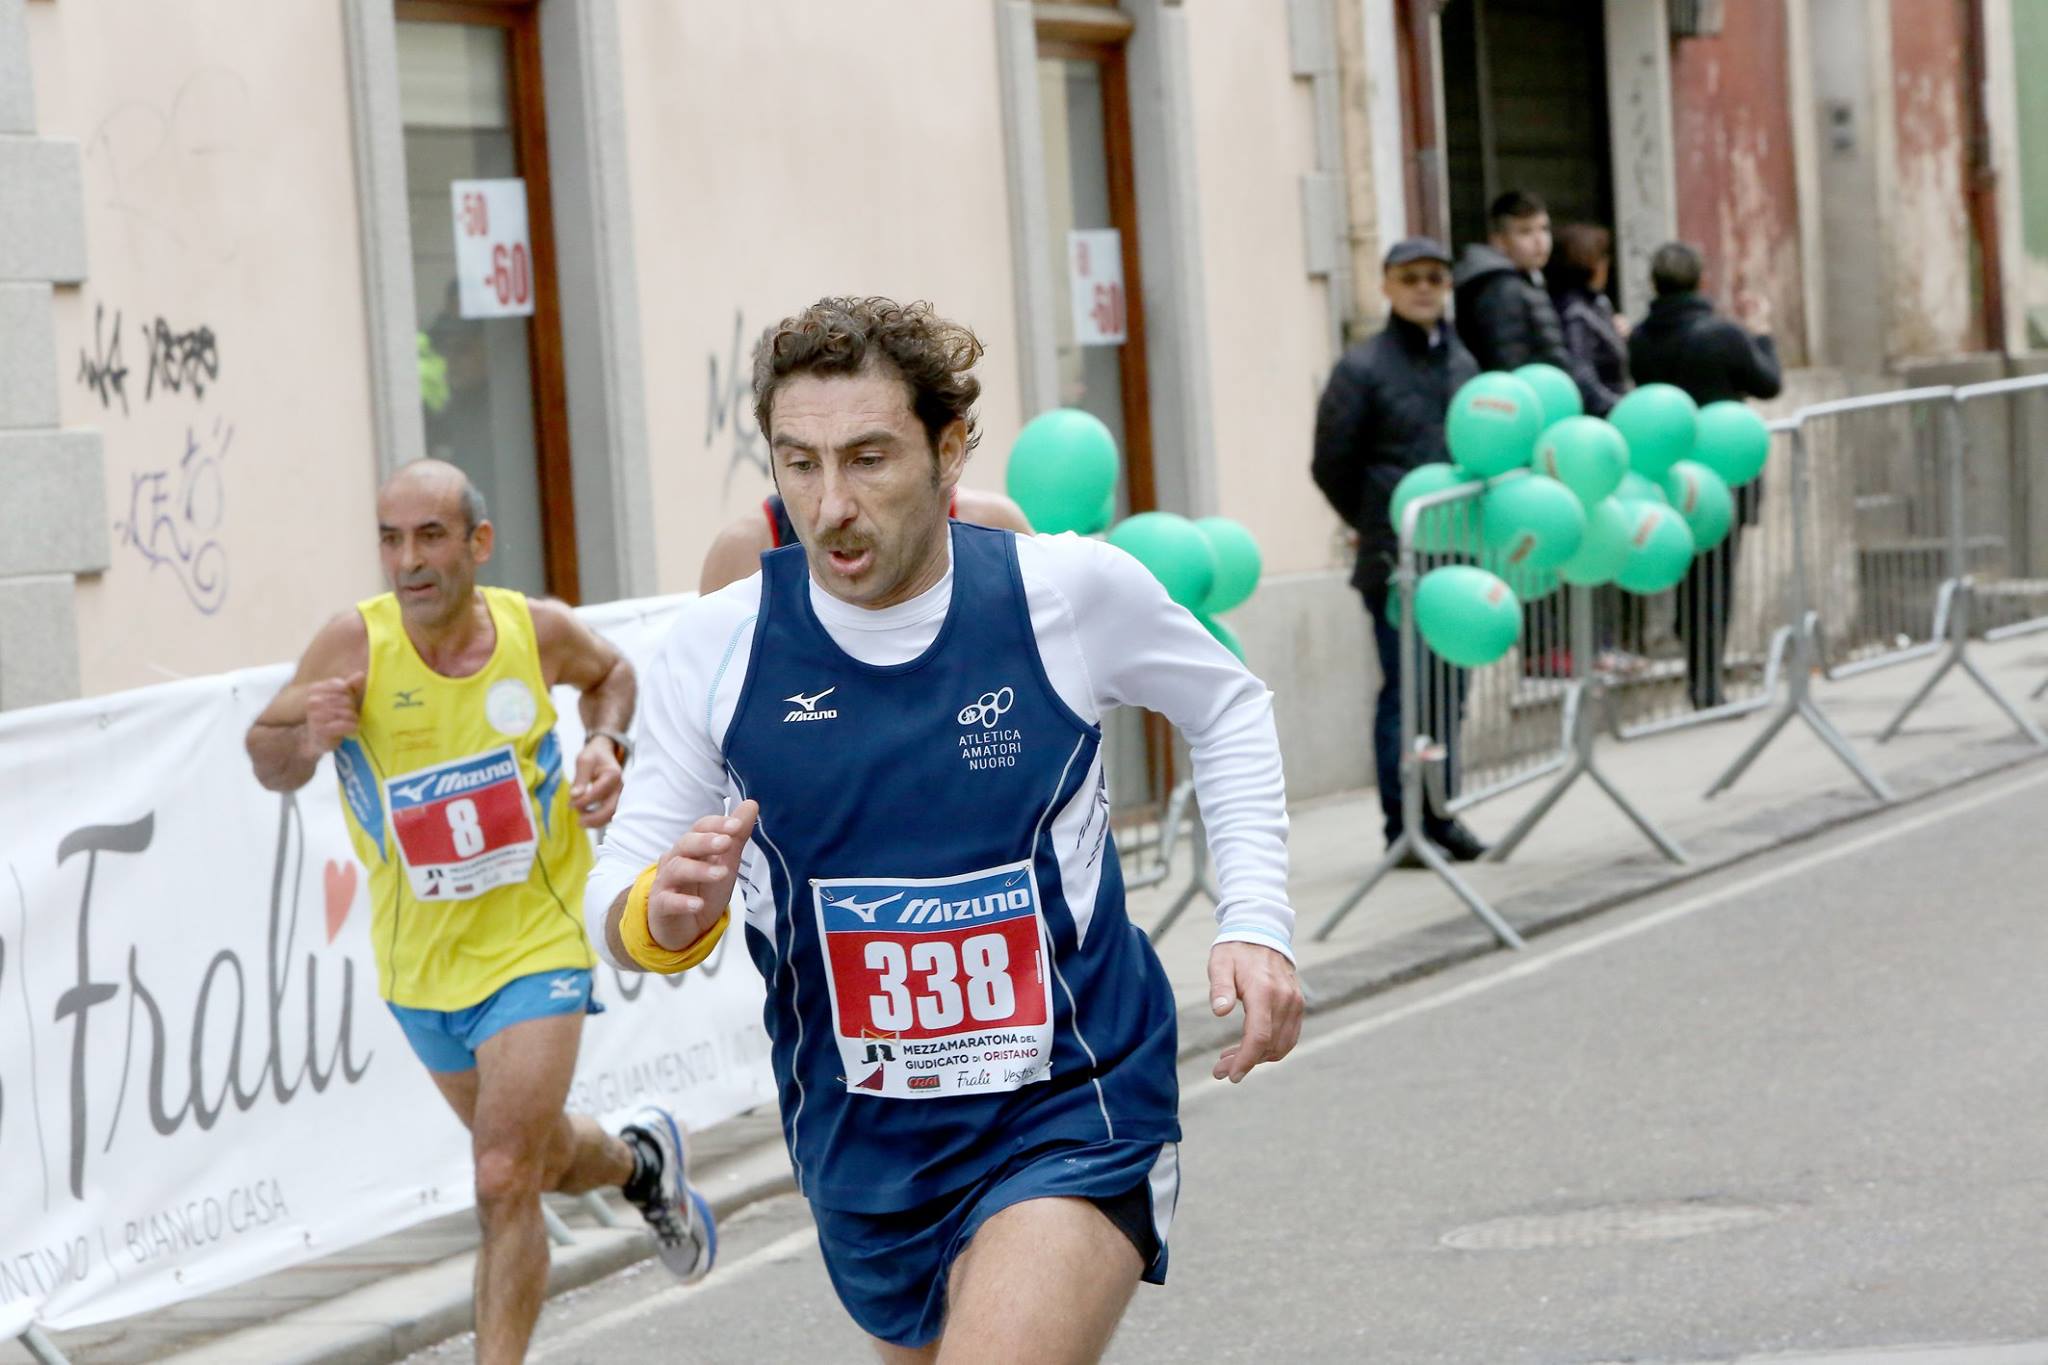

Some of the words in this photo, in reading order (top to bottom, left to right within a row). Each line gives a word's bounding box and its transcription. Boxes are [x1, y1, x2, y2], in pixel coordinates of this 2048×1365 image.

[485, 243, 529, 305] -60
[959, 729, 1021, 746] ATLETICA
[962, 742, 1021, 759] AMATORI
[969, 755, 1015, 770] NUORO
[445, 798, 485, 859] 8
[864, 933, 1016, 1032] 338
[903, 1033, 1018, 1056] MEZZAMARATONA
[1020, 1035, 1037, 1043] DEL
[905, 1054, 969, 1070] GIUDICATO
[983, 1048, 1039, 1062] ORISTANO
[125, 1197, 222, 1264] BIANCO
[228, 1178, 289, 1233] CASA
